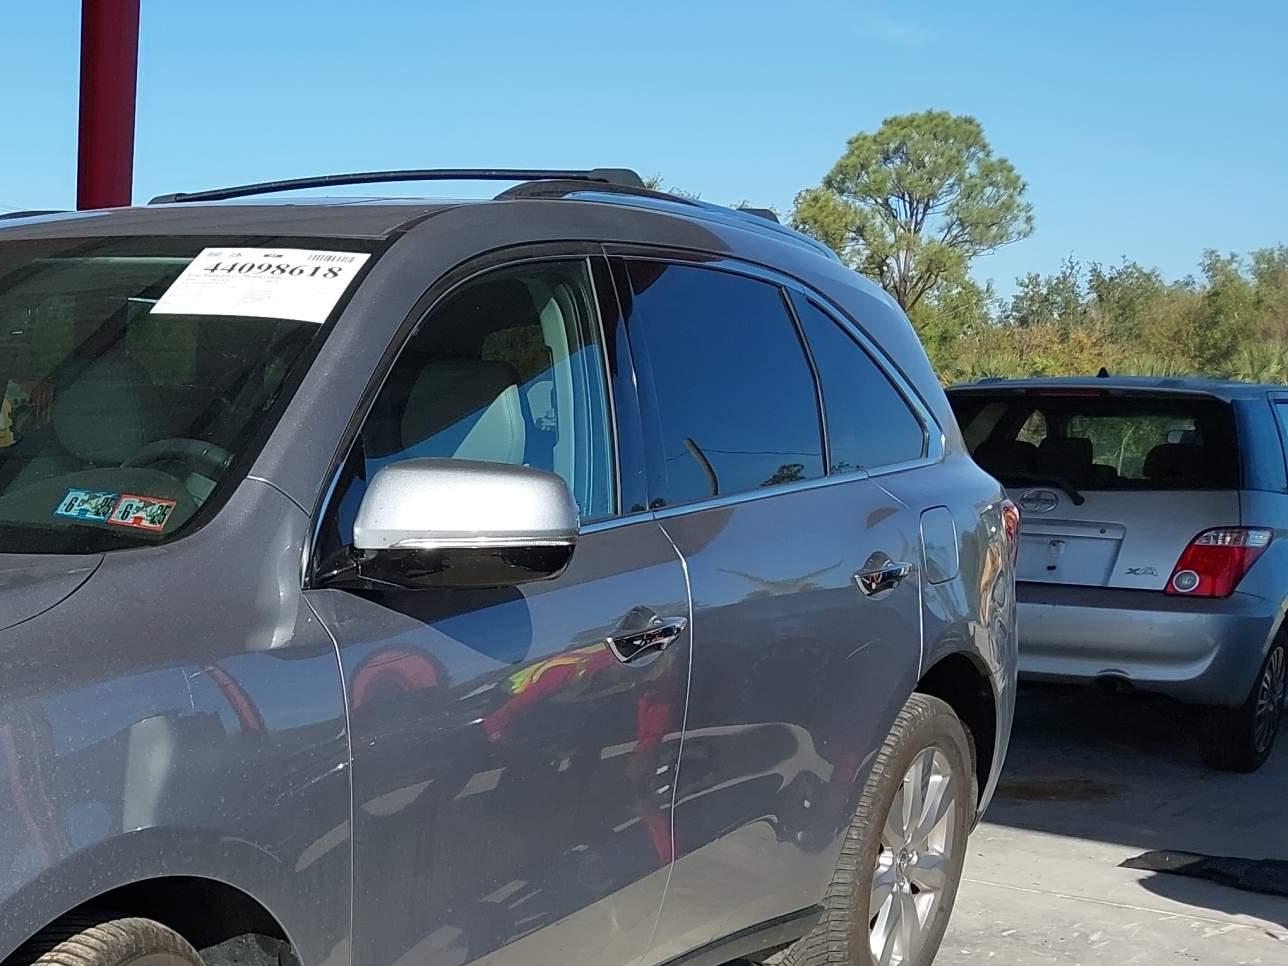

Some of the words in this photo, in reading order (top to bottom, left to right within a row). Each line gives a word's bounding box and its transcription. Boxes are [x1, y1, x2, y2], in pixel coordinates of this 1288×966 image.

[203, 261, 343, 280] 44098618
[65, 496, 79, 513] 6
[121, 504, 133, 520] 6
